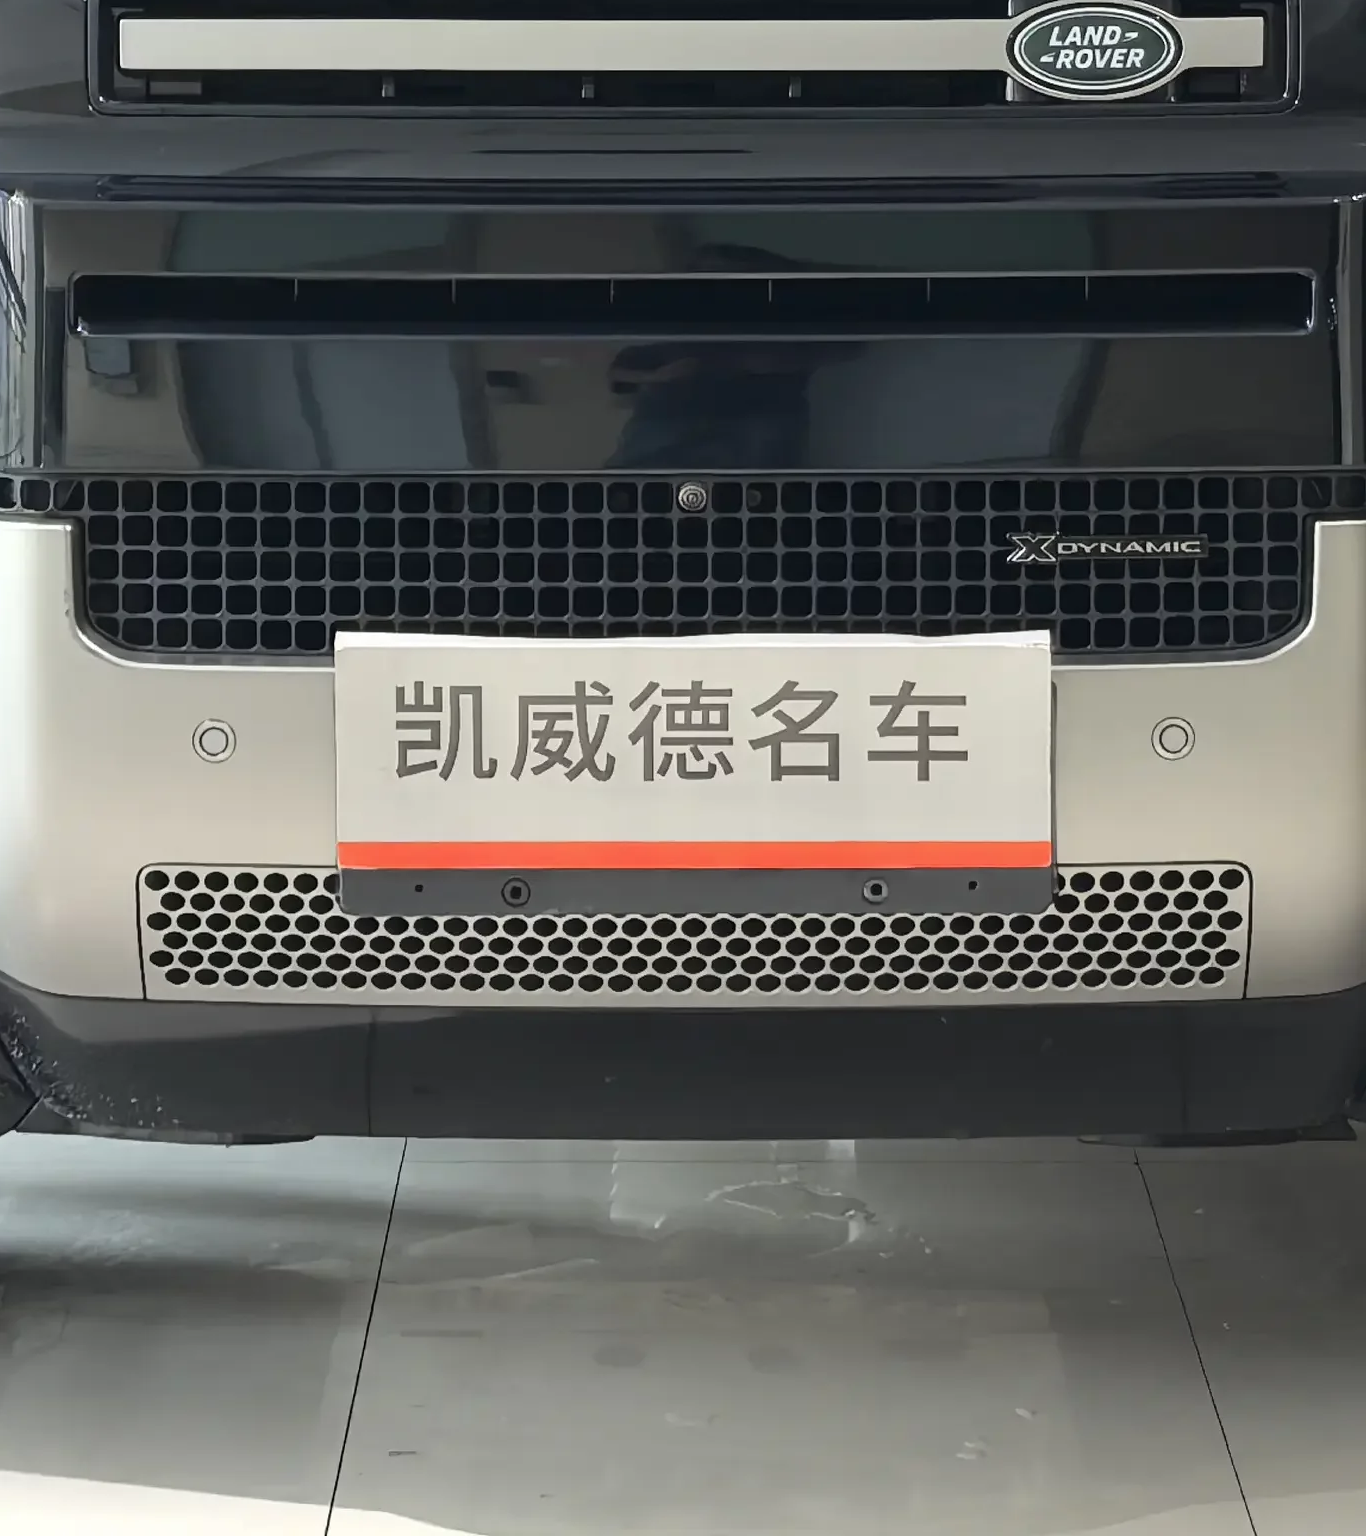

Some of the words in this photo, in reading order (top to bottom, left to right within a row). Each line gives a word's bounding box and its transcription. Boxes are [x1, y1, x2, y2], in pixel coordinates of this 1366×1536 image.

[1048, 25, 1122, 47] LAND
[1055, 48, 1145, 69] ROVER
[395, 679, 969, 782] 凯威德名车
